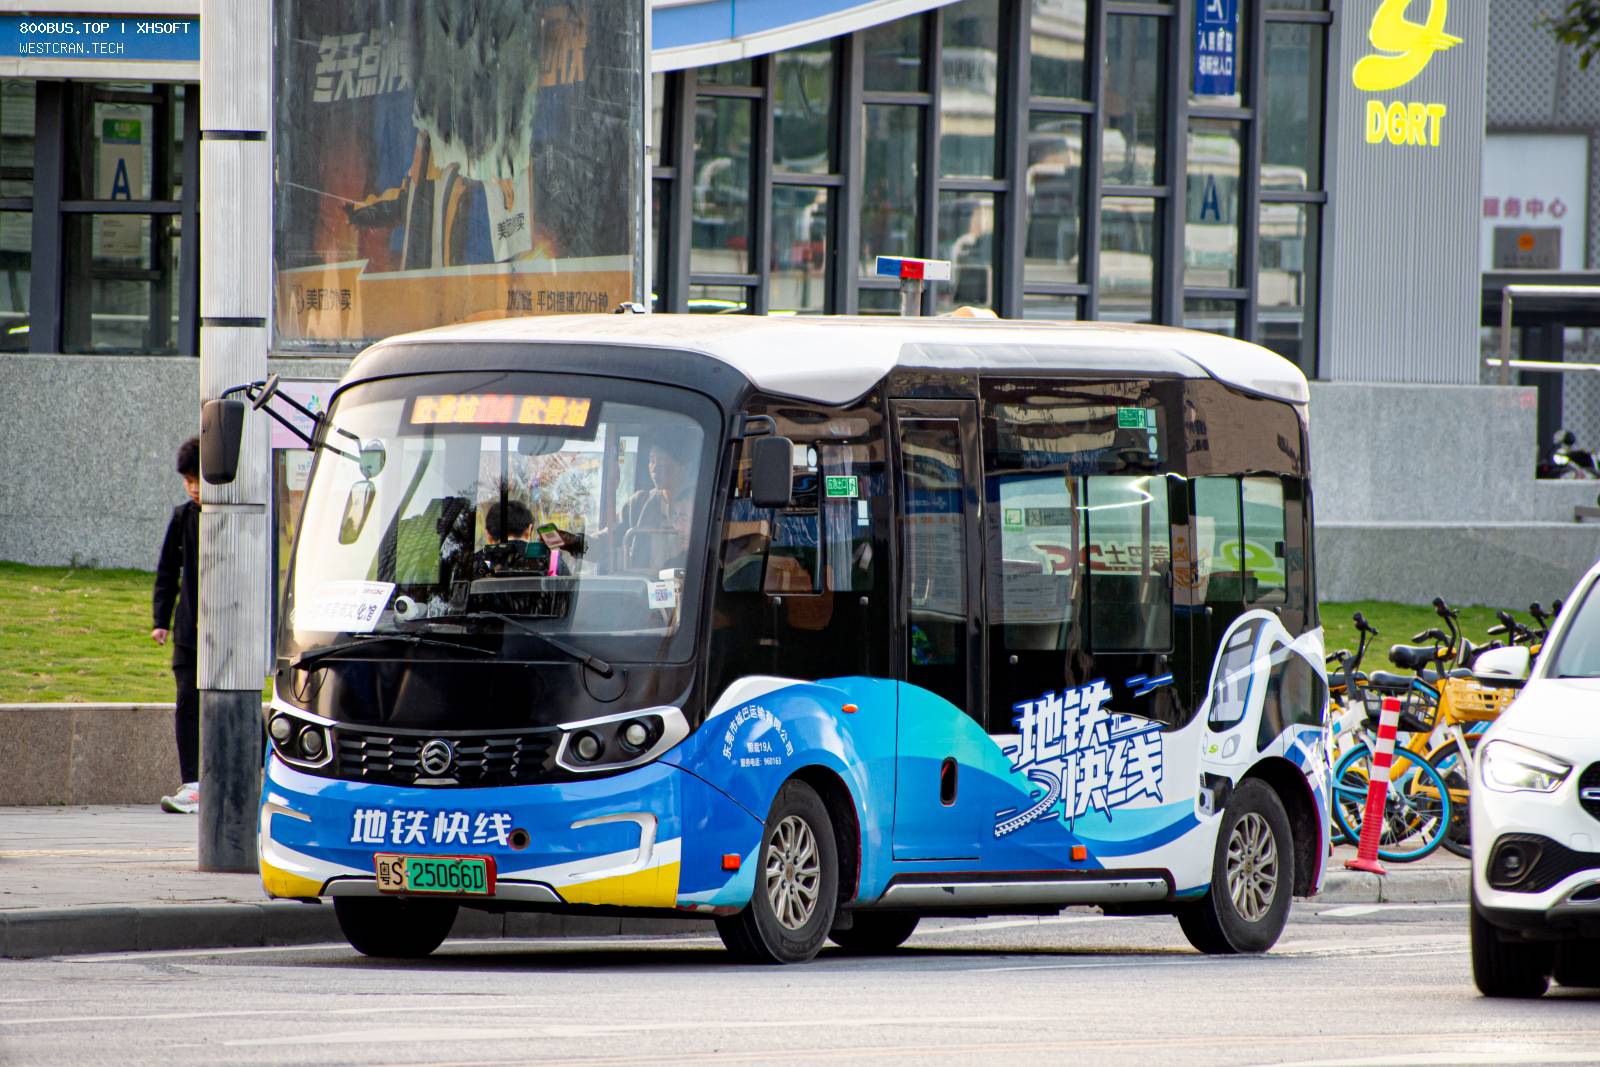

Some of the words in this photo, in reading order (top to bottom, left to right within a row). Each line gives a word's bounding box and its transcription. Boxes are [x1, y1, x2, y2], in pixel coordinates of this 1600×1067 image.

[1366, 100, 1447, 147] DGRT
[111, 157, 131, 200] A
[1201, 173, 1220, 221] A
[1482, 195, 1568, 219] 服务中心
[1010, 679, 1113, 773] 地铁
[1060, 731, 1163, 831] 快线
[350, 808, 512, 846] 地铁快线
